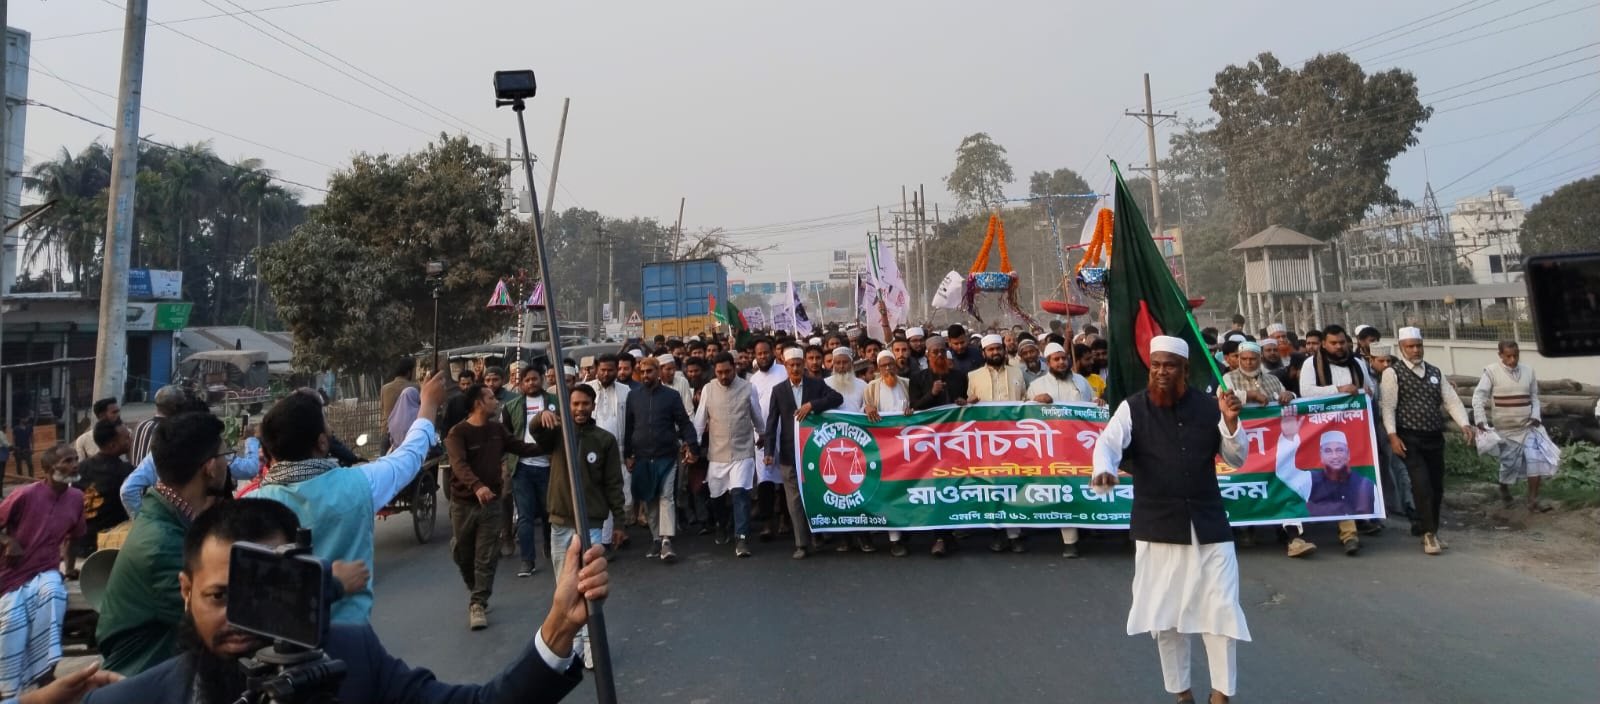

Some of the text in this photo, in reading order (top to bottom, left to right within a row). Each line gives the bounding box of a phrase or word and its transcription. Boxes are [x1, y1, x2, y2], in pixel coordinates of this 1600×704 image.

[1308, 409, 1364, 424] বাংলাদেশ
[896, 418, 1062, 462] নির্বাচনী
[907, 483, 1017, 505] মাওলানা
[1024, 483, 1074, 504] মোঃ
[868, 516, 887, 525] ২০২৬
[948, 510, 981, 520] এমপি
